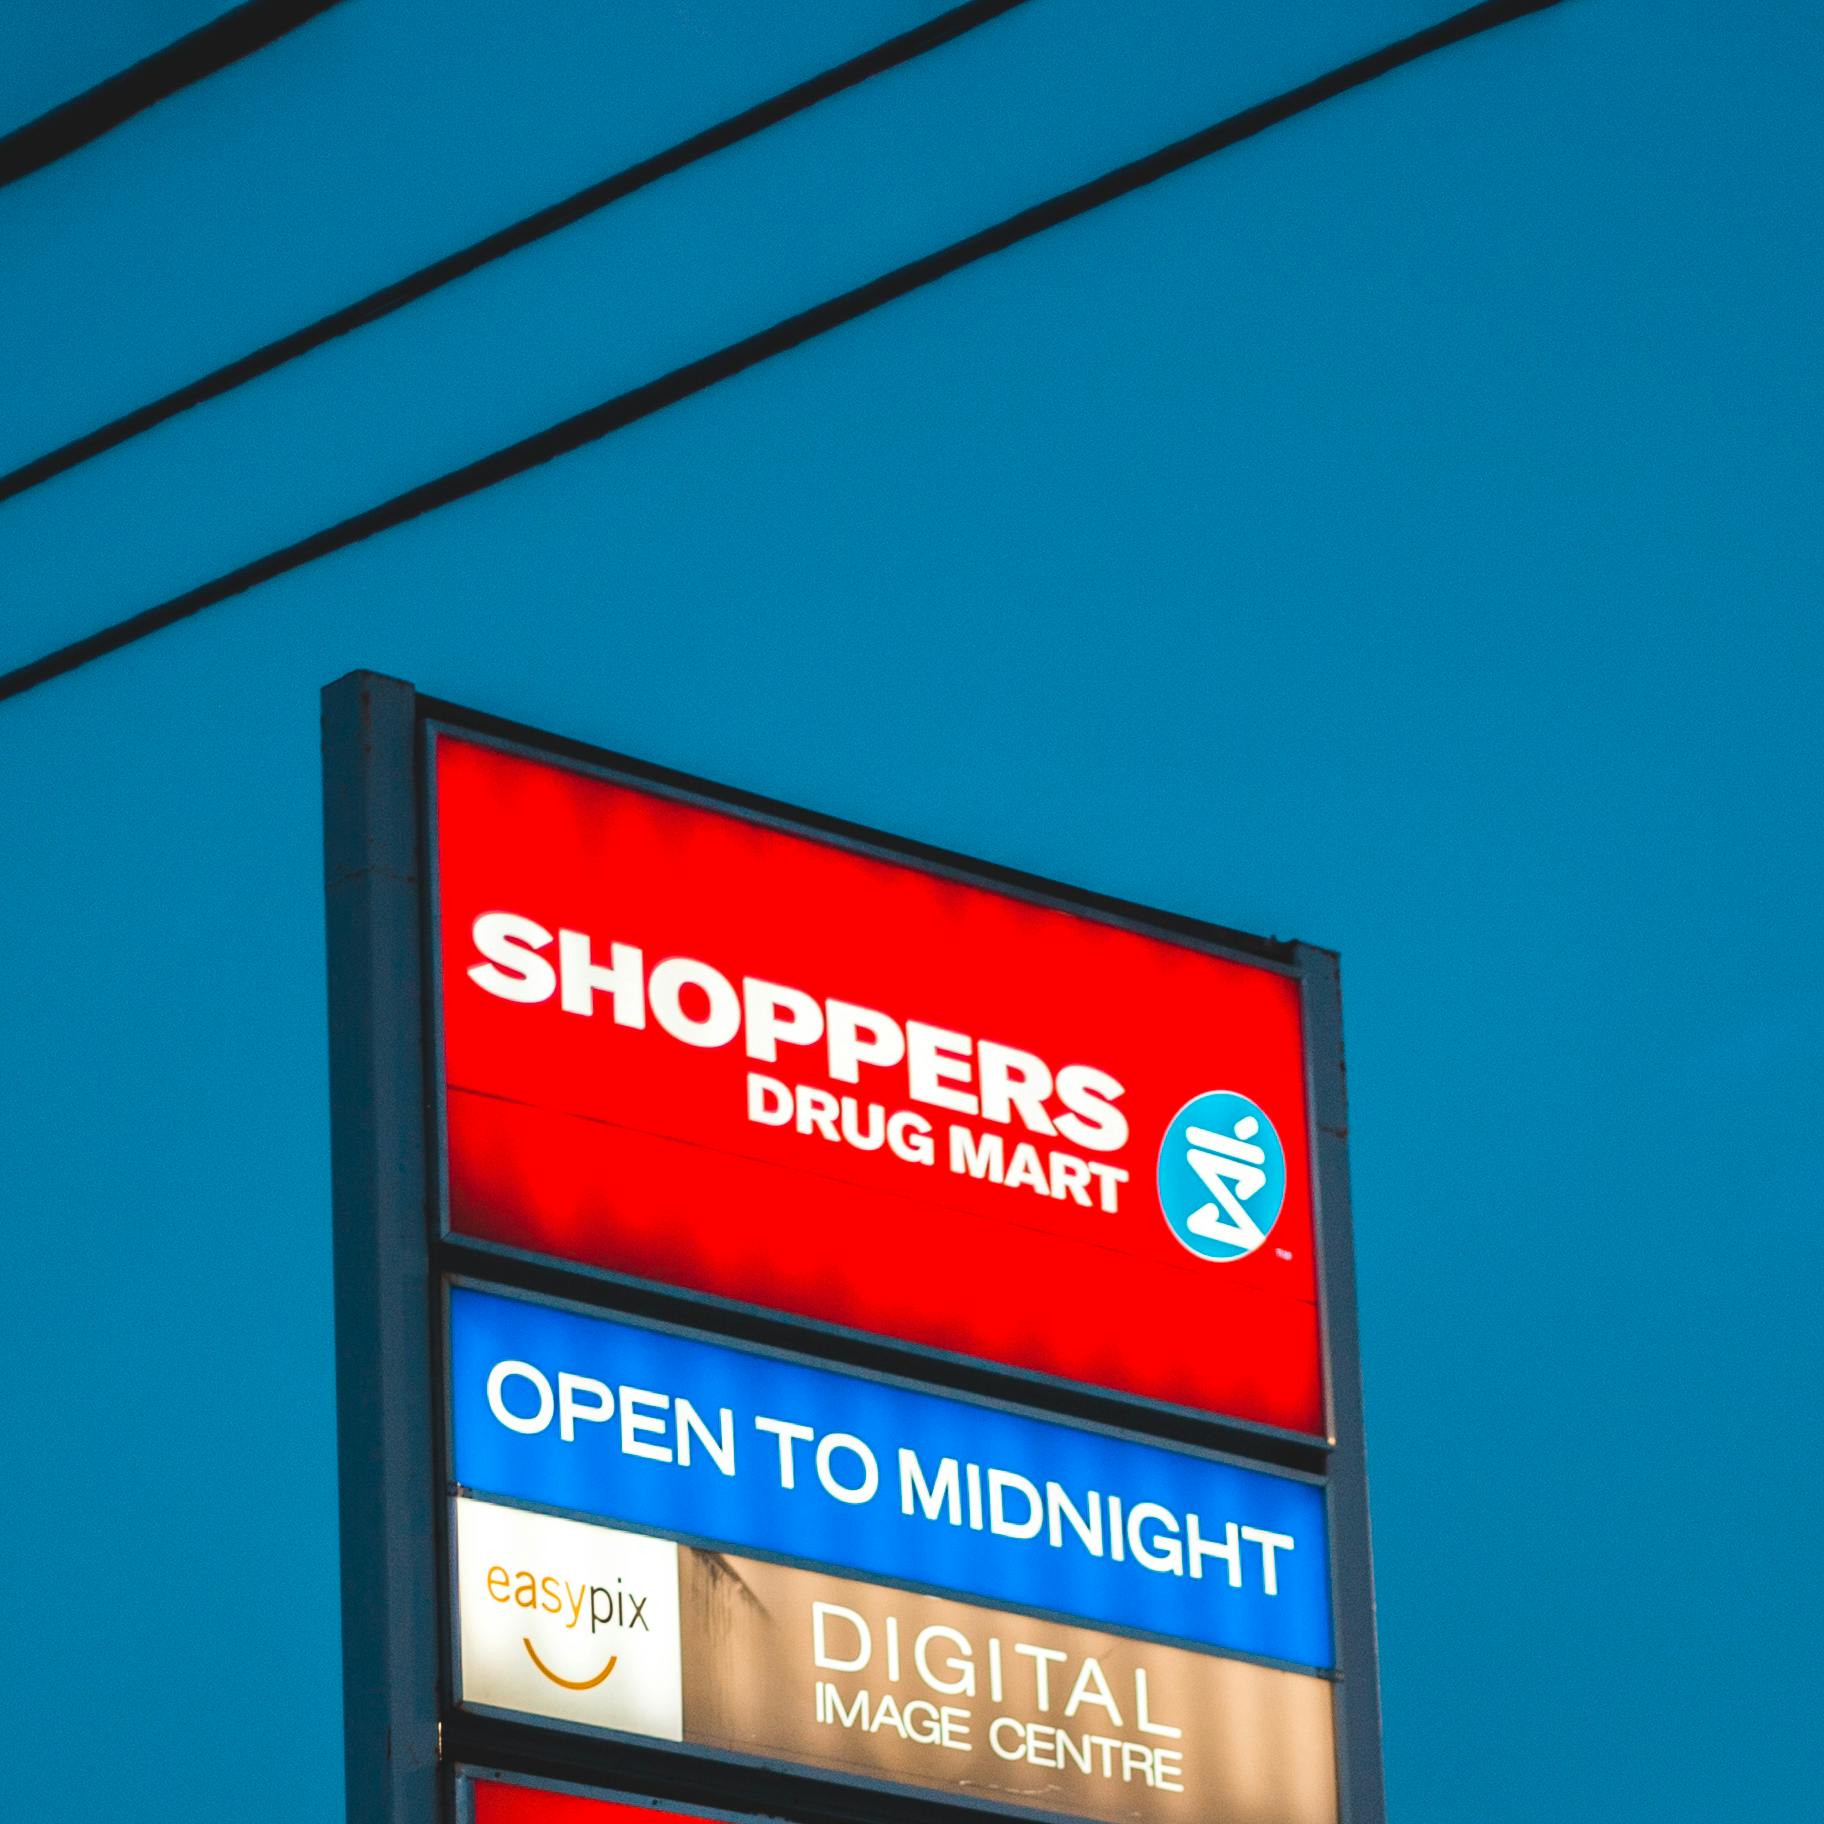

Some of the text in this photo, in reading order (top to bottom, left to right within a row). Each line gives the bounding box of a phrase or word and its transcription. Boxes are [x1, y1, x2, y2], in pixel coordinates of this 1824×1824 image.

[467, 911, 1130, 1153] SHOPPERS
[746, 1073, 1130, 1214] DRUG MART
[486, 1360, 1295, 1597] OPEN TO MIDNIGHT
[486, 1559, 650, 1634] easypix
[811, 1601, 1184, 1740] DIGITAL
[815, 1680, 1185, 1794] IMAGE CENTRE
